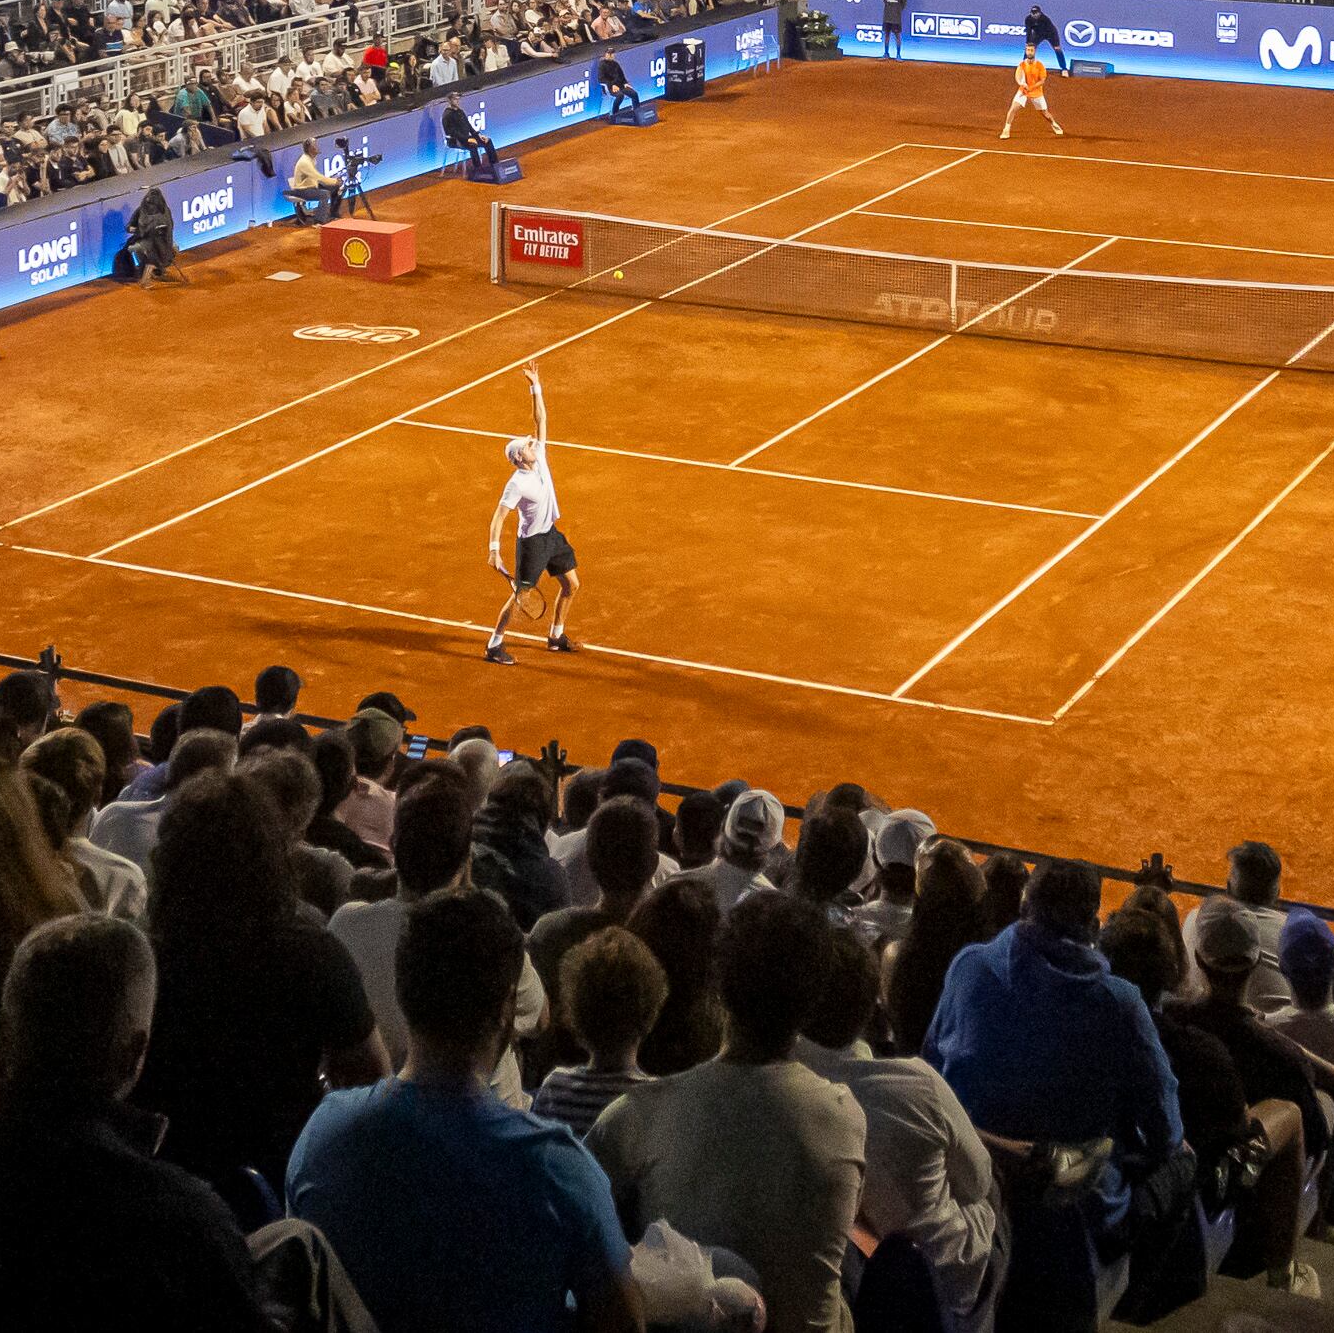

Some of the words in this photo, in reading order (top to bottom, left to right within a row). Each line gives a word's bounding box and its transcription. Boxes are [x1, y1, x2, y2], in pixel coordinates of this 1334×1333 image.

[856, 30, 883, 43] 0:52
[561, 102, 584, 118] SOLAR
[193, 213, 226, 235] SOLAR
[513, 225, 579, 247] Emirates
[523, 243, 539, 257] FLY
[540, 244, 570, 260] BETTER
[30, 263, 68, 286] SOLAR
